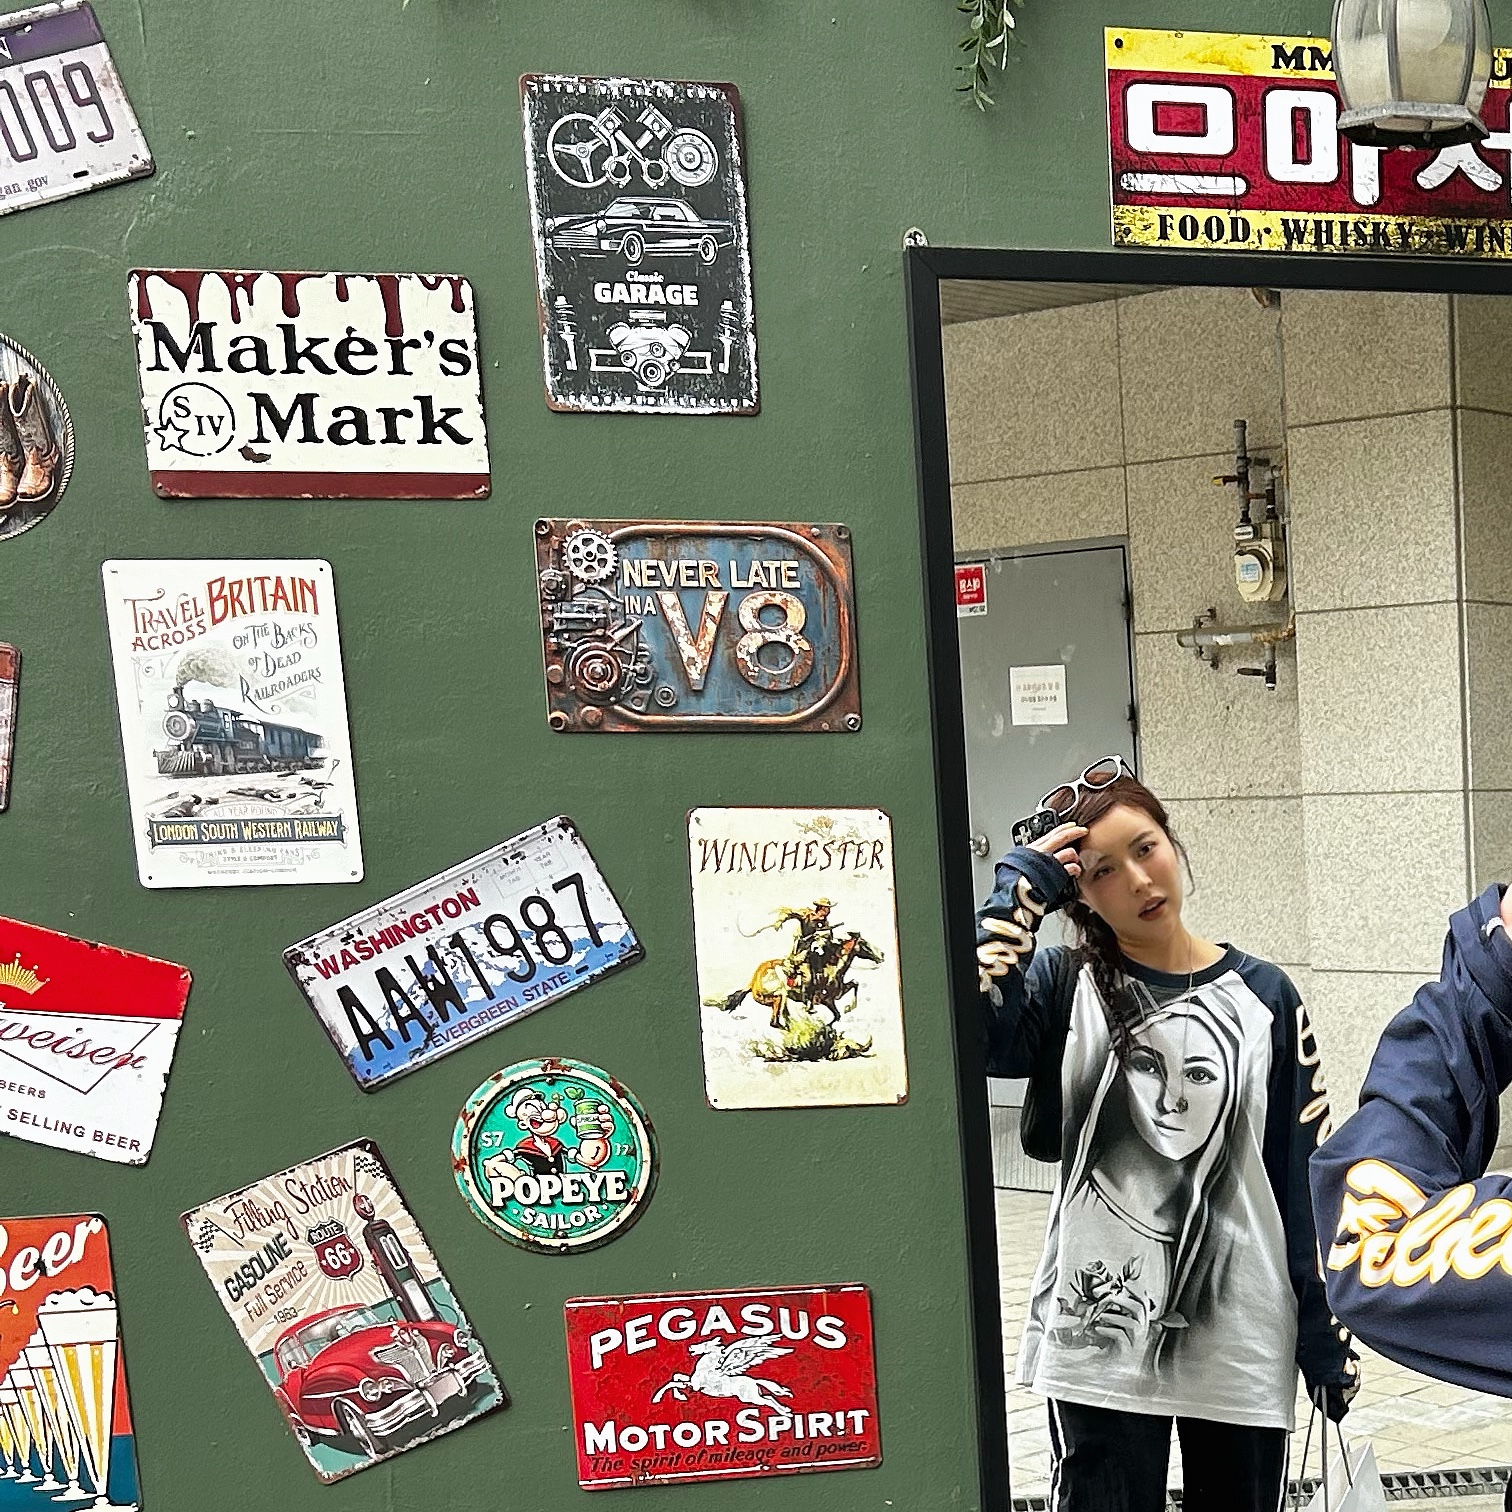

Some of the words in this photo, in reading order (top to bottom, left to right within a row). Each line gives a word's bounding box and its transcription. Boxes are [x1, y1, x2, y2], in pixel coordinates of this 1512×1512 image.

[1157, 213, 1252, 244] FOOD
[1280, 217, 1413, 251] WHISKY
[593, 281, 699, 307] GARAGE
[143, 319, 473, 377] Maker's
[247, 392, 474, 446] Mark
[621, 559, 723, 589] NEVER
[729, 560, 801, 589] LATE
[206, 575, 321, 627] BRITAIN
[624, 594, 641, 615] IN
[642, 594, 657, 615] A
[131, 619, 208, 652] ACROSS
[655, 589, 815, 692] V8
[152, 822, 199, 843] LONDON
[200, 821, 240, 842] SOUTH
[241, 820, 293, 841] WESTERN
[293, 819, 340, 841] RAILWAY
[699, 838, 886, 874] WINCHESTER
[313, 886, 482, 982] WASHINGTON
[335, 872, 603, 1062] AAW1987
[432, 996, 520, 1049] EVERGREEN
[522, 971, 571, 1003] STATE
[7, 1107, 86, 1138] SELLING
[92, 1128, 141, 1153] BEER
[284, 1174, 353, 1215] Station
[489, 1170, 629, 1208] POPEYE
[309, 1222, 341, 1243] ROUTE
[519, 1206, 603, 1231] SAILOR
[224, 1231, 293, 1303] GASOLINE
[324, 1242, 353, 1270] 66
[243, 1293, 269, 1323] Full
[263, 1260, 308, 1306] Service
[589, 1303, 848, 1370] PEGASUS
[583, 1418, 731, 1456] MOTOR
[590, 1456, 625, 1473] The
[631, 1454, 681, 1472] spirit
[706, 1447, 776, 1466] mileage
[780, 1442, 813, 1459] and
